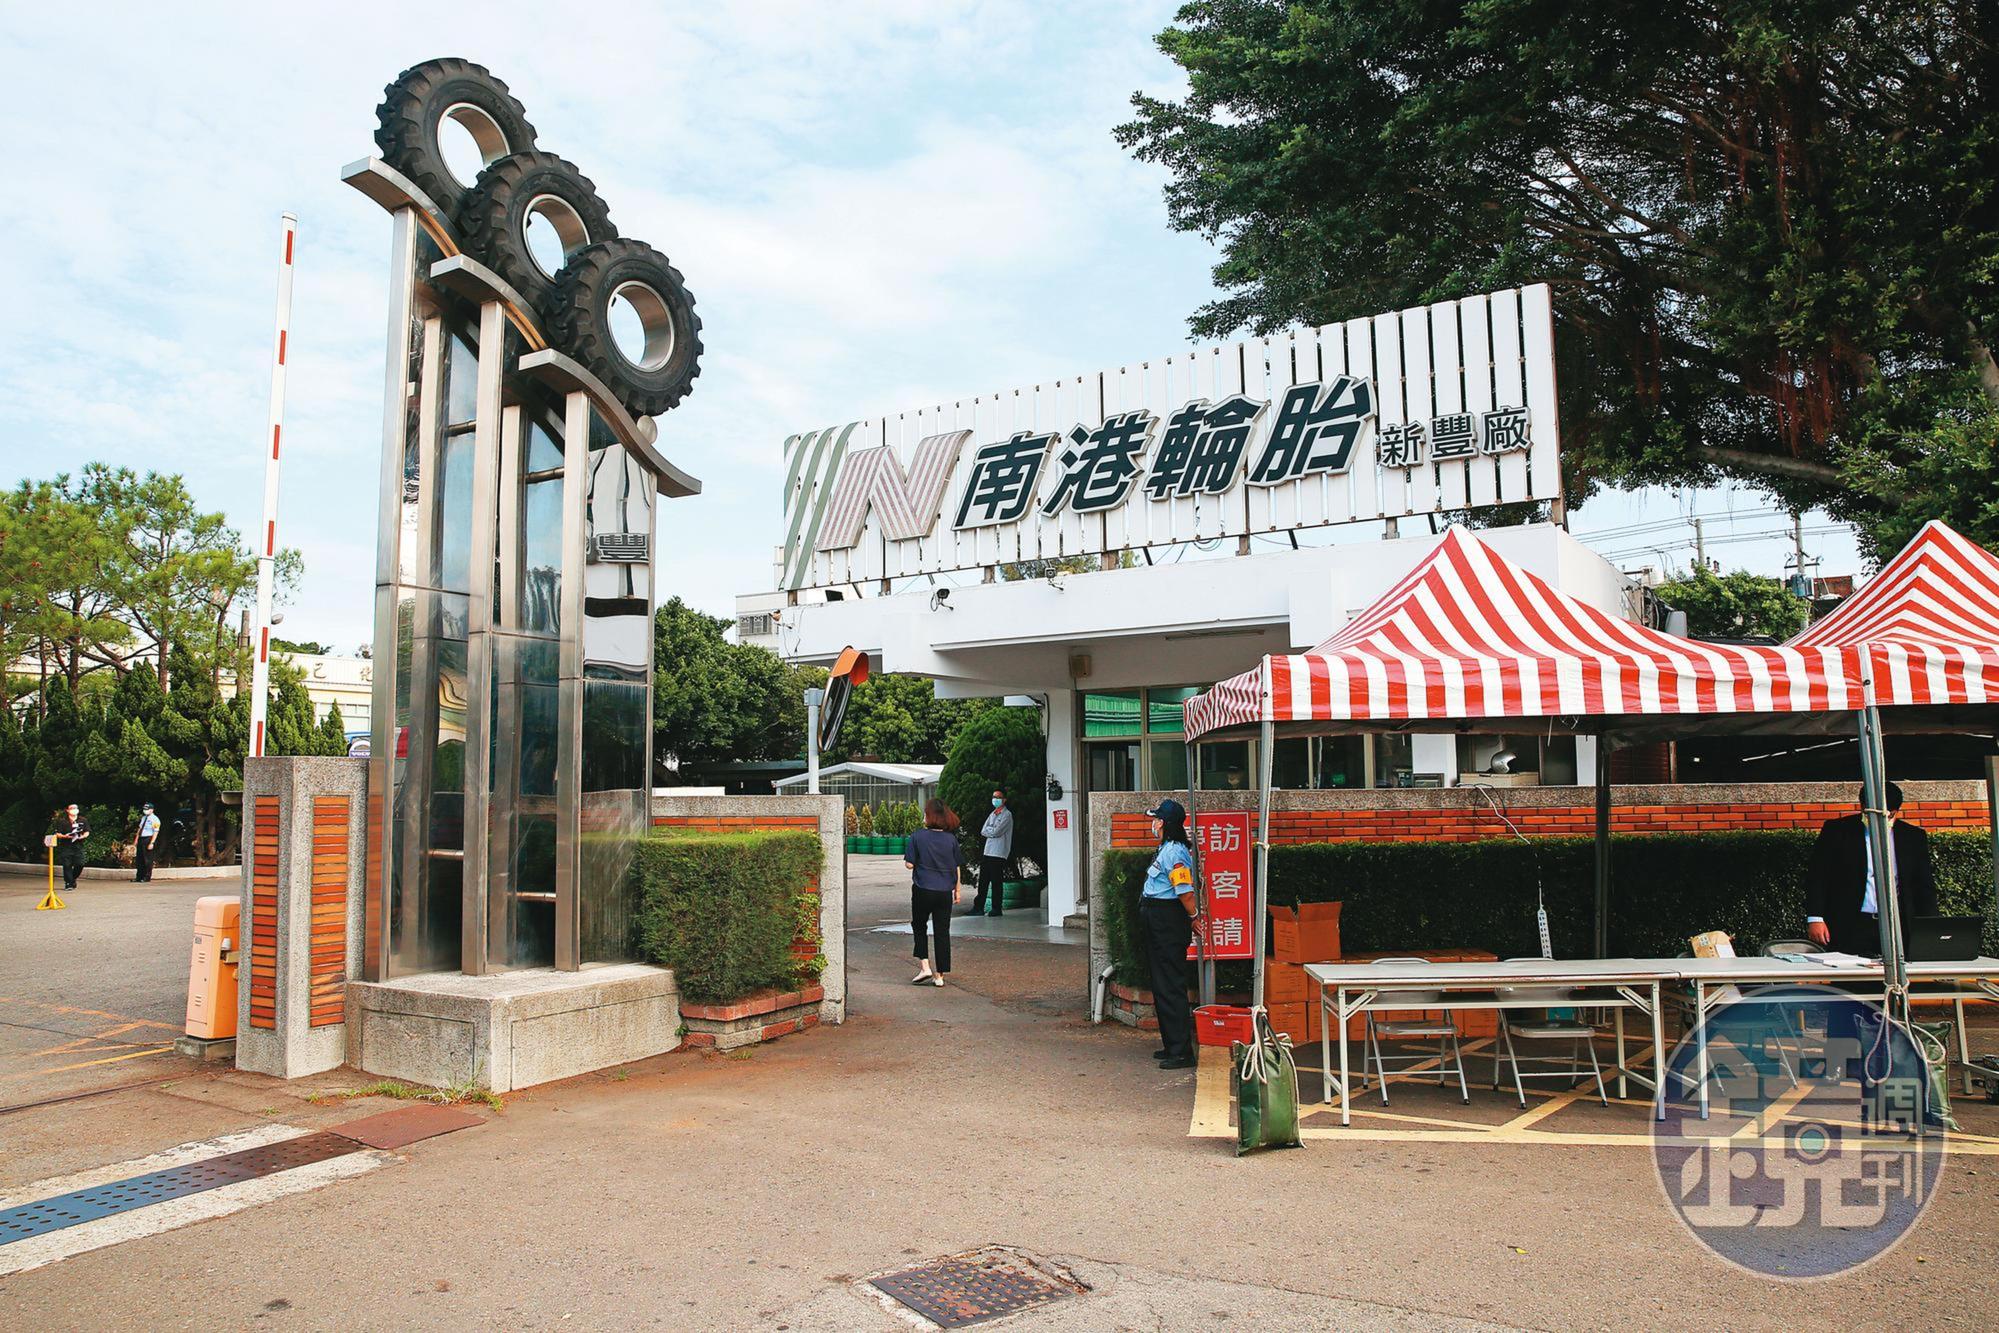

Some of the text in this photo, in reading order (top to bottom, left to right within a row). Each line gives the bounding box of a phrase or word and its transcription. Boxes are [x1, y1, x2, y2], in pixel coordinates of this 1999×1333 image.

[953, 374, 1530, 531] 南港輪胎 新豐廠
[1209, 823, 1243, 946] 訪客請
